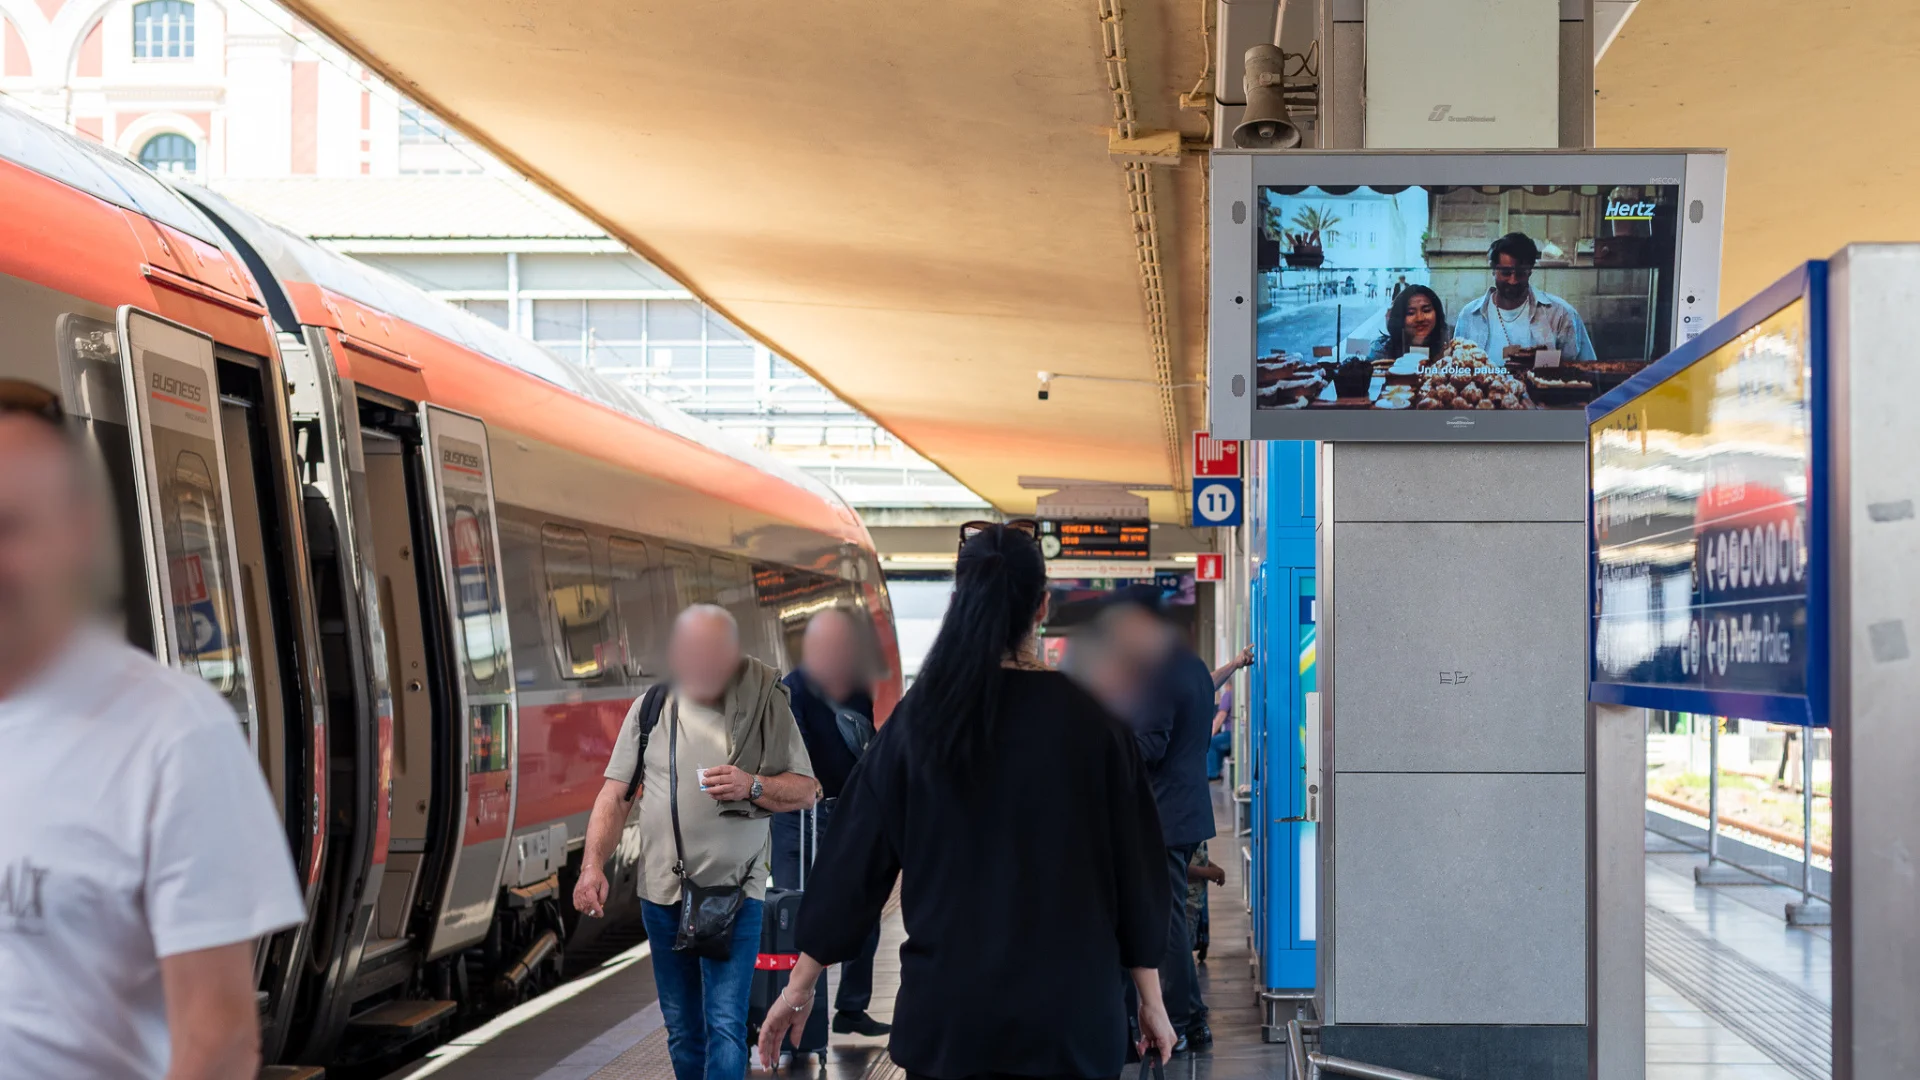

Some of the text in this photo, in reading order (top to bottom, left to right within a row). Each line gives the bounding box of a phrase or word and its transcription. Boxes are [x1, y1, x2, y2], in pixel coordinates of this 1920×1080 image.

[1649, 177, 1681, 185] IMECON
[1604, 201, 1656, 216] Hertz
[1416, 365, 1511, 377] Una dolce pausa.
[152, 372, 202, 402] BUSINESS
[444, 450, 478, 468] BUSINESS
[1207, 493, 1227, 512] 11
